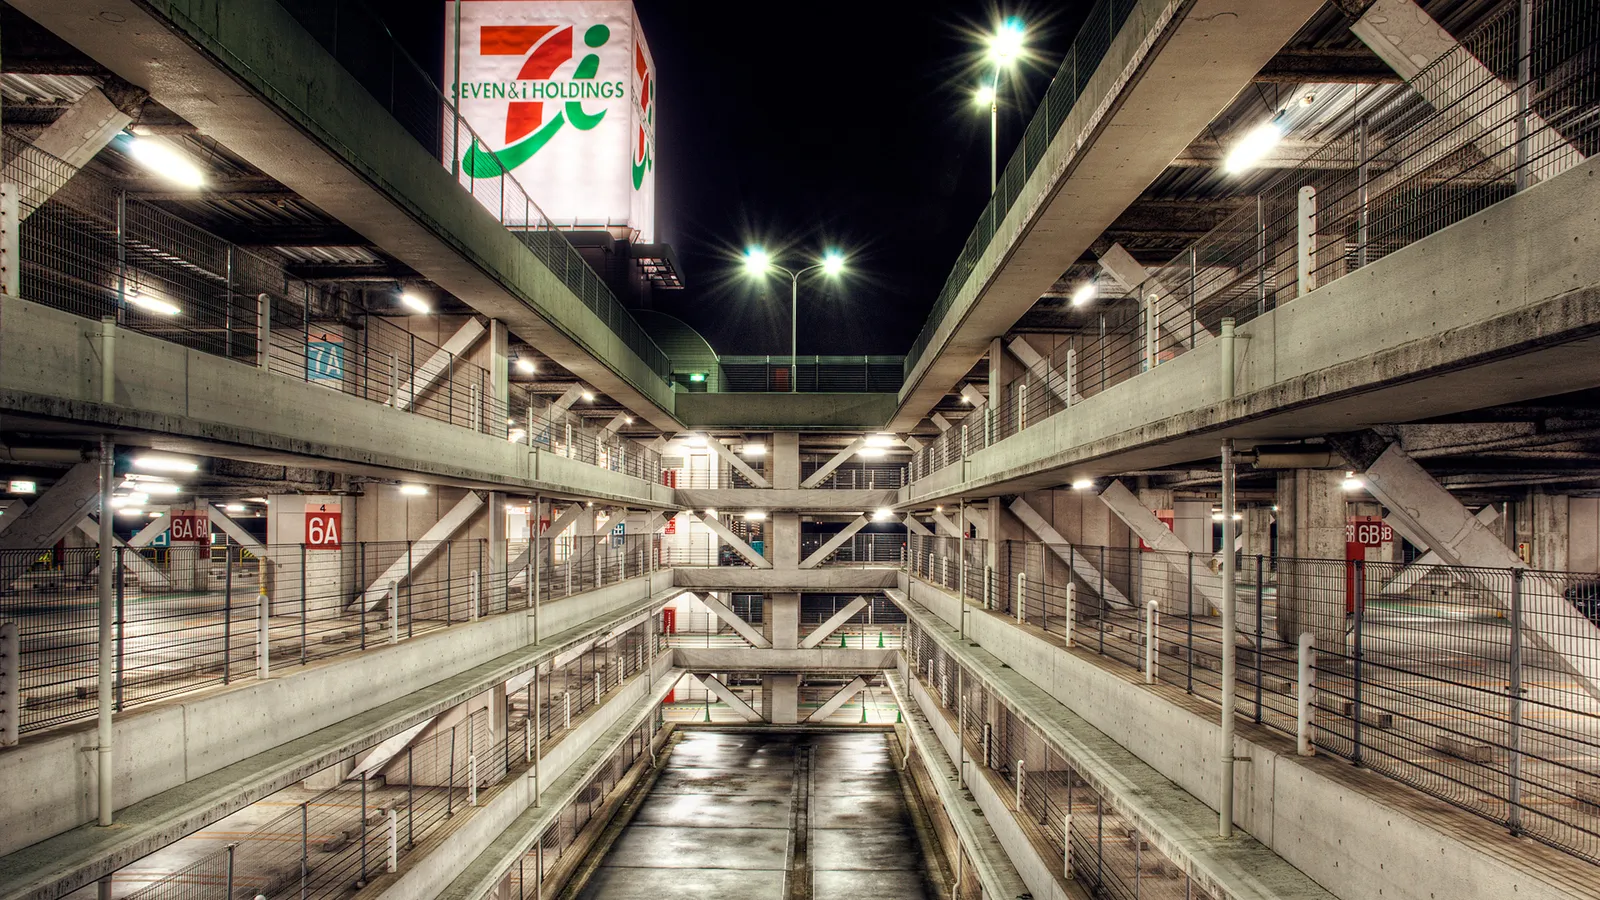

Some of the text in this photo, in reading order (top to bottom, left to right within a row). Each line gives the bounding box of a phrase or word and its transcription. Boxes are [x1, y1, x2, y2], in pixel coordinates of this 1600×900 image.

[532, 82, 624, 99] HOLDINGS
[310, 346, 340, 375] 7A
[320, 504, 326, 512] 4
[172, 519, 193, 538] 6A
[196, 519, 208, 538] 6A
[309, 517, 339, 545] 6A
[1358, 524, 1380, 544] 6B
